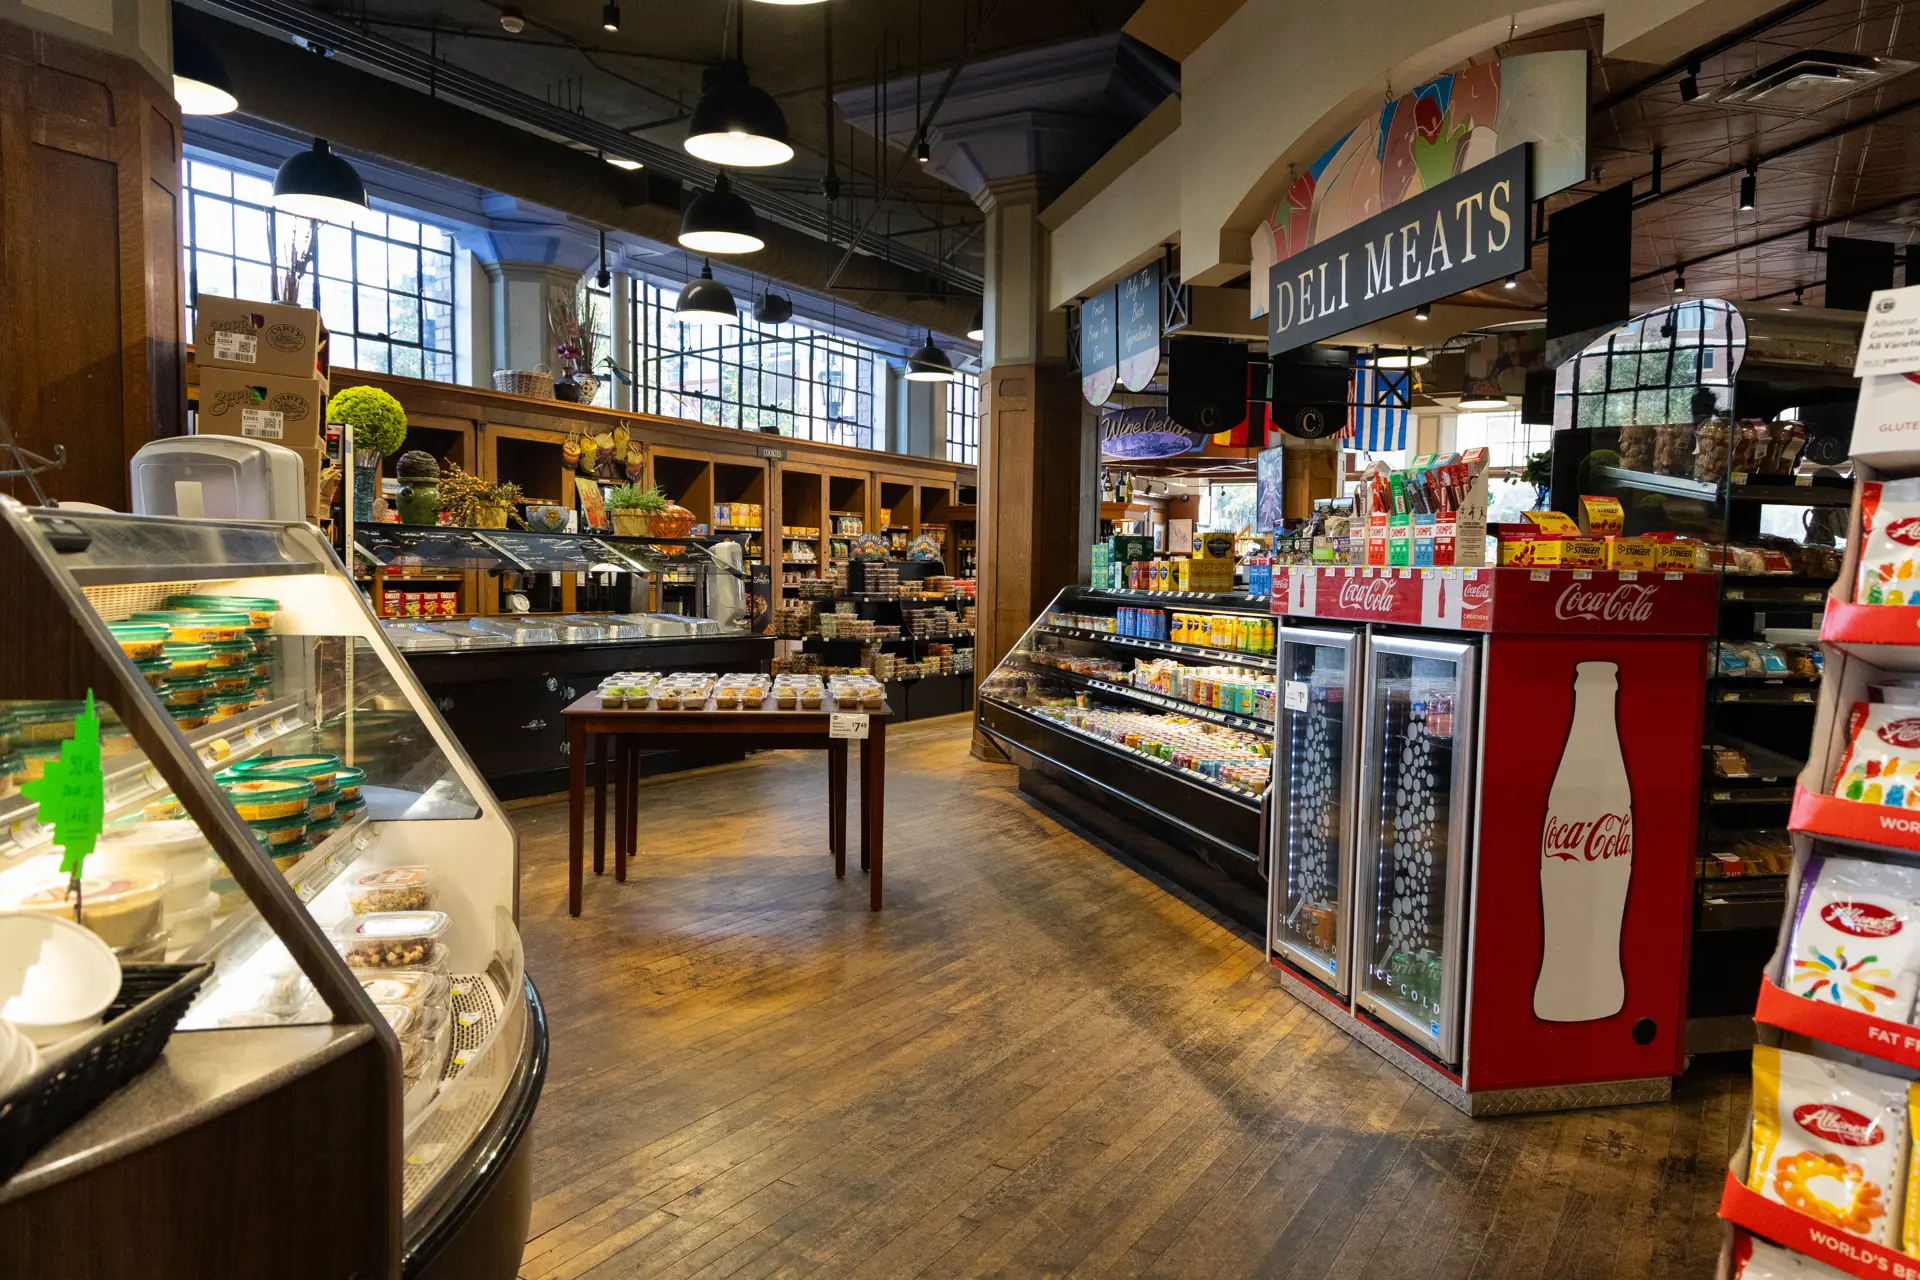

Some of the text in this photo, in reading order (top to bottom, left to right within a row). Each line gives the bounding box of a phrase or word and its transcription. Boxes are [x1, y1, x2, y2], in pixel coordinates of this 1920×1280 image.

[1275, 180, 1513, 334] DELI MEATS
[273, 394, 307, 409] DIRTY
[1101, 411, 1142, 441] Wine
[1371, 527, 1384, 537] CHOMPS
[1391, 527, 1407, 538] CHOMPS
[1416, 526, 1432, 537] CHOMPS
[1436, 525, 1453, 535] CHOMPS
[1574, 546, 1601, 554] STINGER
[1625, 548, 1651, 556] STINGER
[1668, 549, 1693, 558] STINGER
[1339, 577, 1398, 612] Coca-Cola
[1464, 583, 1492, 598] Coca-Cola
[1555, 582, 1660, 621] Coca-Cola
[1543, 813, 1632, 862] Coca-Cola
[1369, 963, 1440, 1015] ICE COLD
[1868, 1026, 1900, 1046] FAT
[1809, 1227, 1920, 1280] WORLD'S BE
